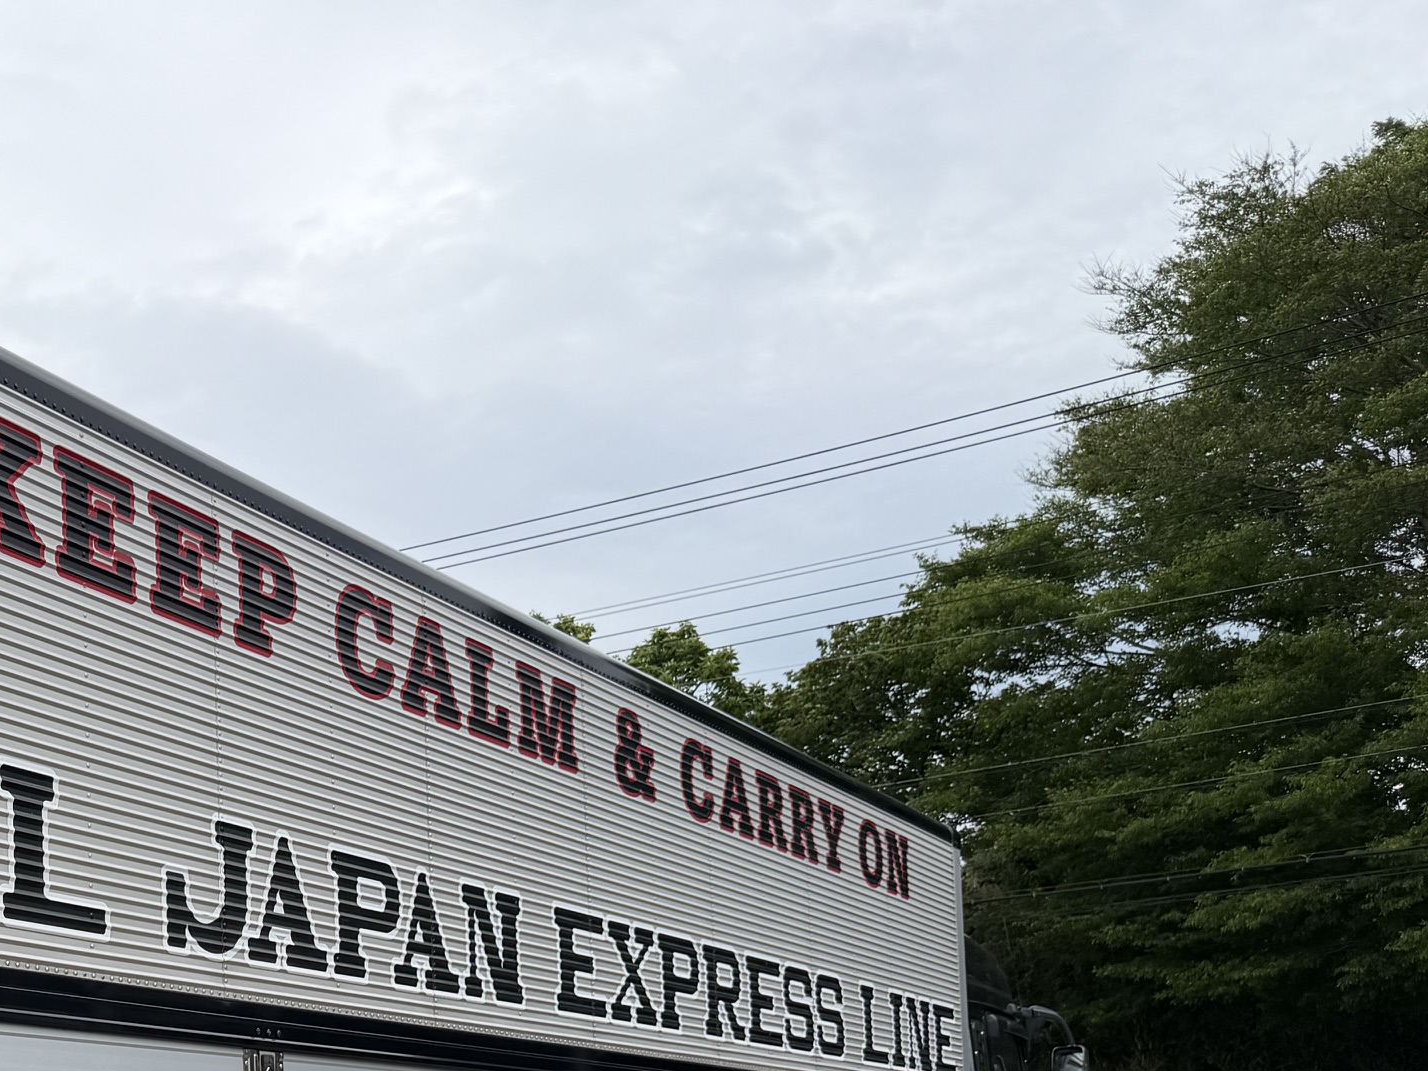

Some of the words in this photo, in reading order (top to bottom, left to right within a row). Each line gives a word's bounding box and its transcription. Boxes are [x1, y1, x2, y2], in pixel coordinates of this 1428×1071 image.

[334, 584, 579, 774] CALM
[614, 707, 656, 802] &
[680, 738, 845, 873] CARRY
[858, 818, 910, 900] ON
[164, 816, 525, 1007] JAPAN
[553, 903, 845, 1059] EXPRESS
